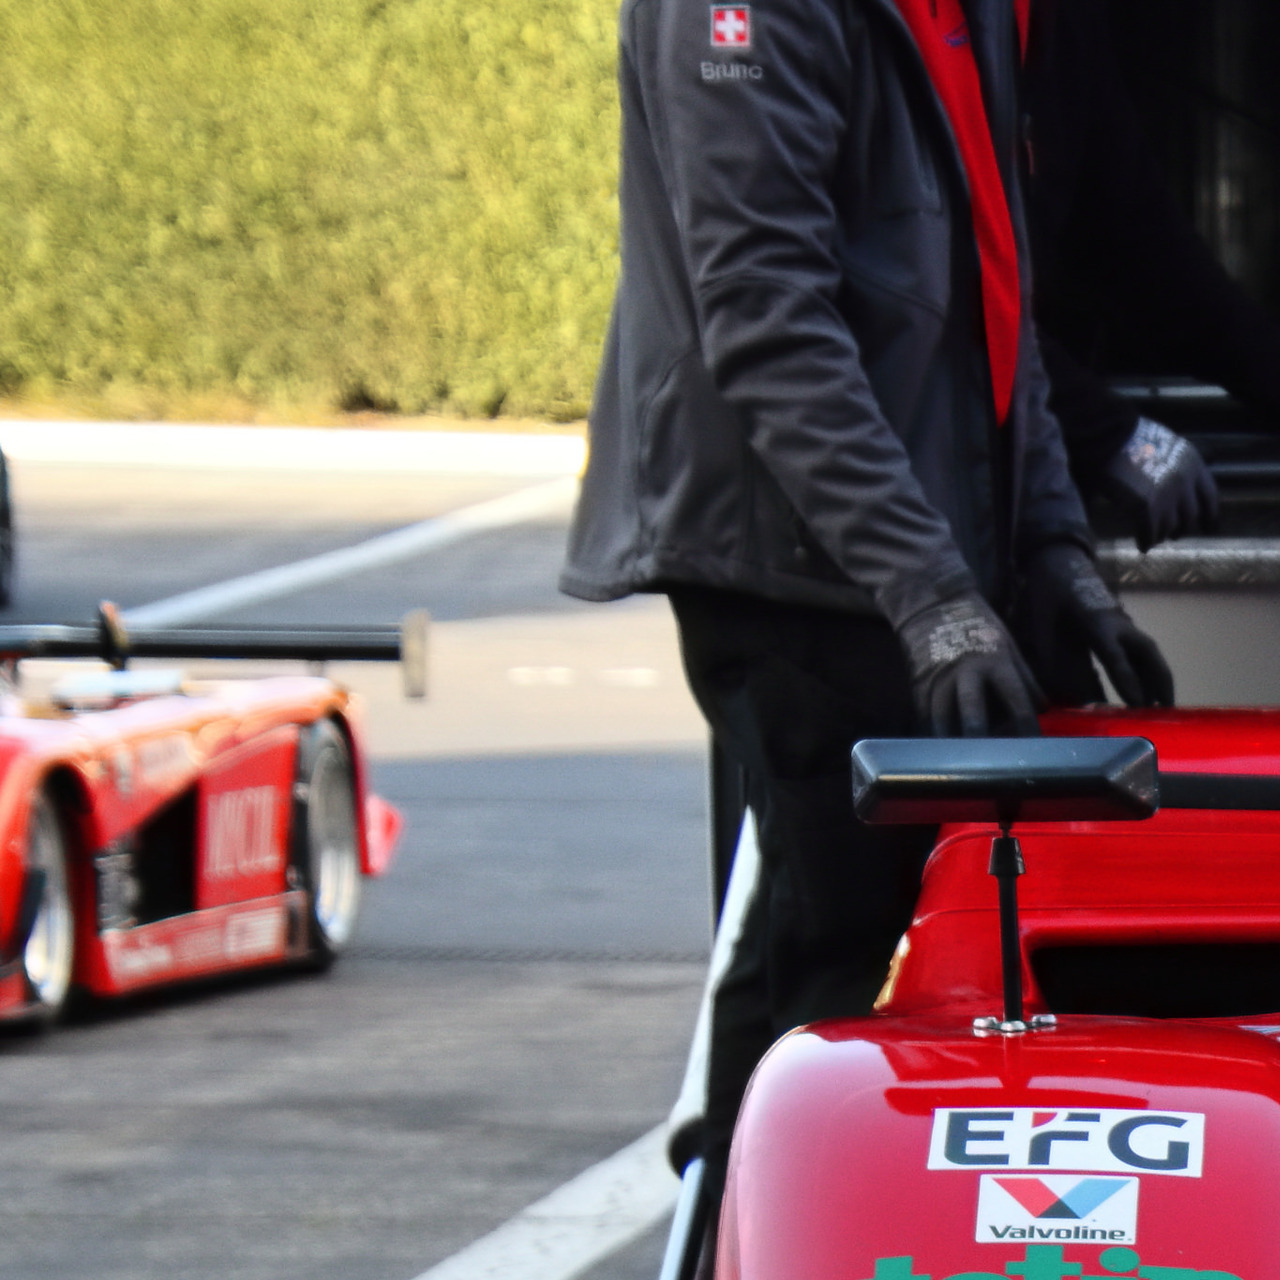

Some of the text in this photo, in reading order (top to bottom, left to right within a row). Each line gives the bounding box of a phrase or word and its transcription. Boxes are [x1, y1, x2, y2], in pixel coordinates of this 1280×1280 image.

[700, 61, 764, 80] Bruno
[945, 1111, 1190, 1171] EFG
[988, 1224, 1128, 1241] Valvoline
